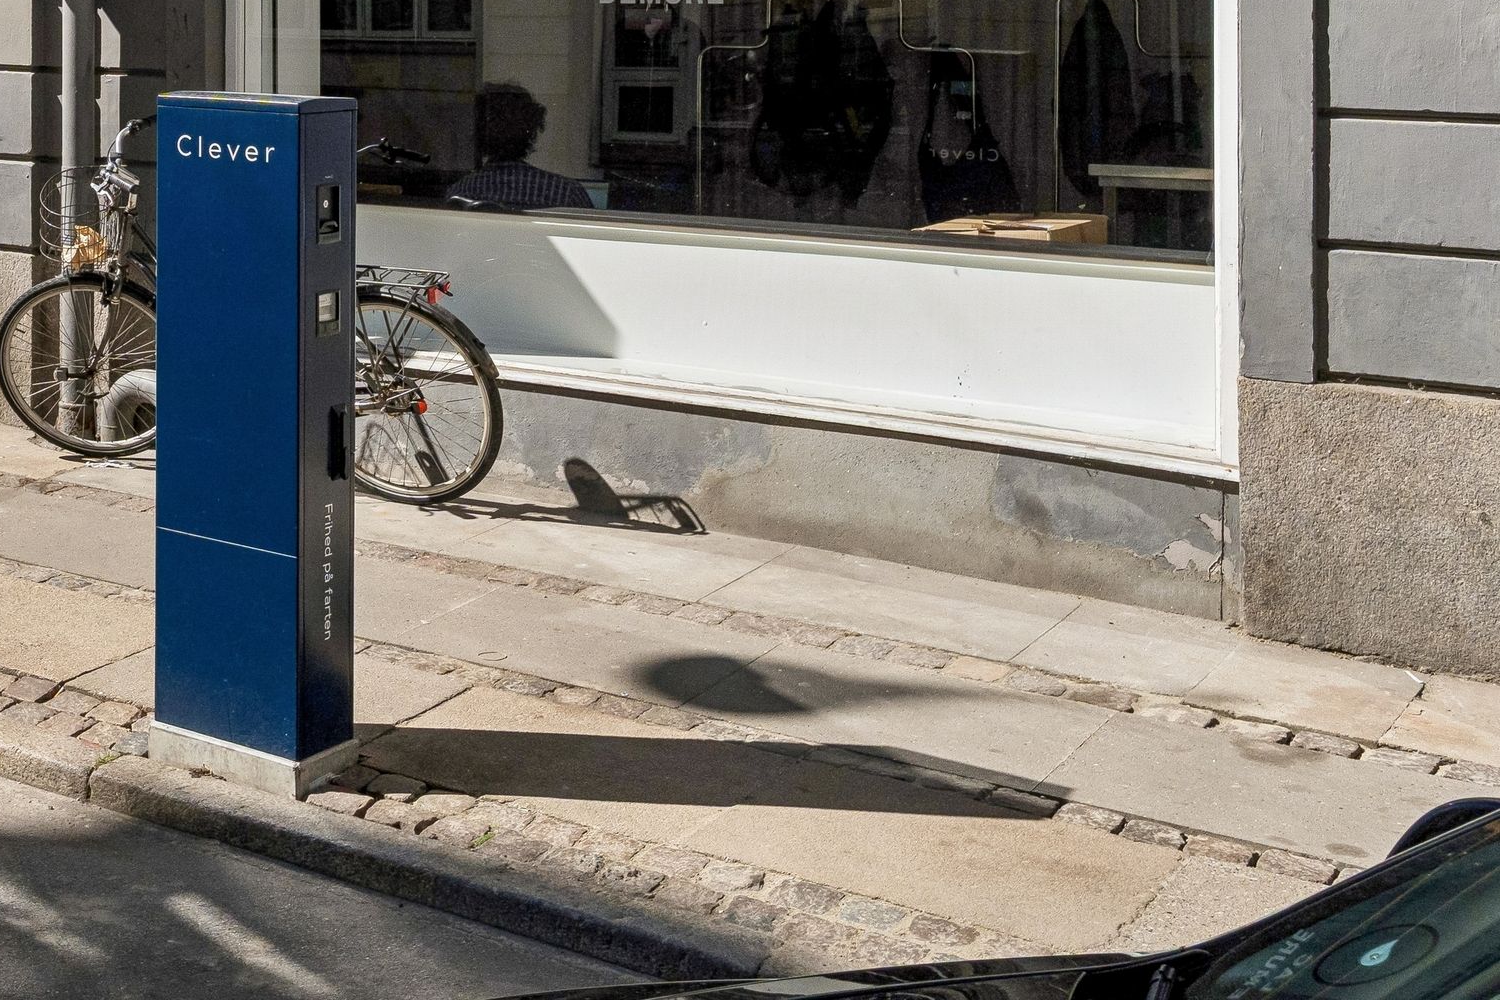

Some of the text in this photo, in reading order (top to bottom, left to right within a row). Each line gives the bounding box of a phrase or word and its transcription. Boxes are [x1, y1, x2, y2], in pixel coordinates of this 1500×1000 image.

[176, 134, 276, 164] Clever
[322, 503, 334, 641] Frihed på farten
